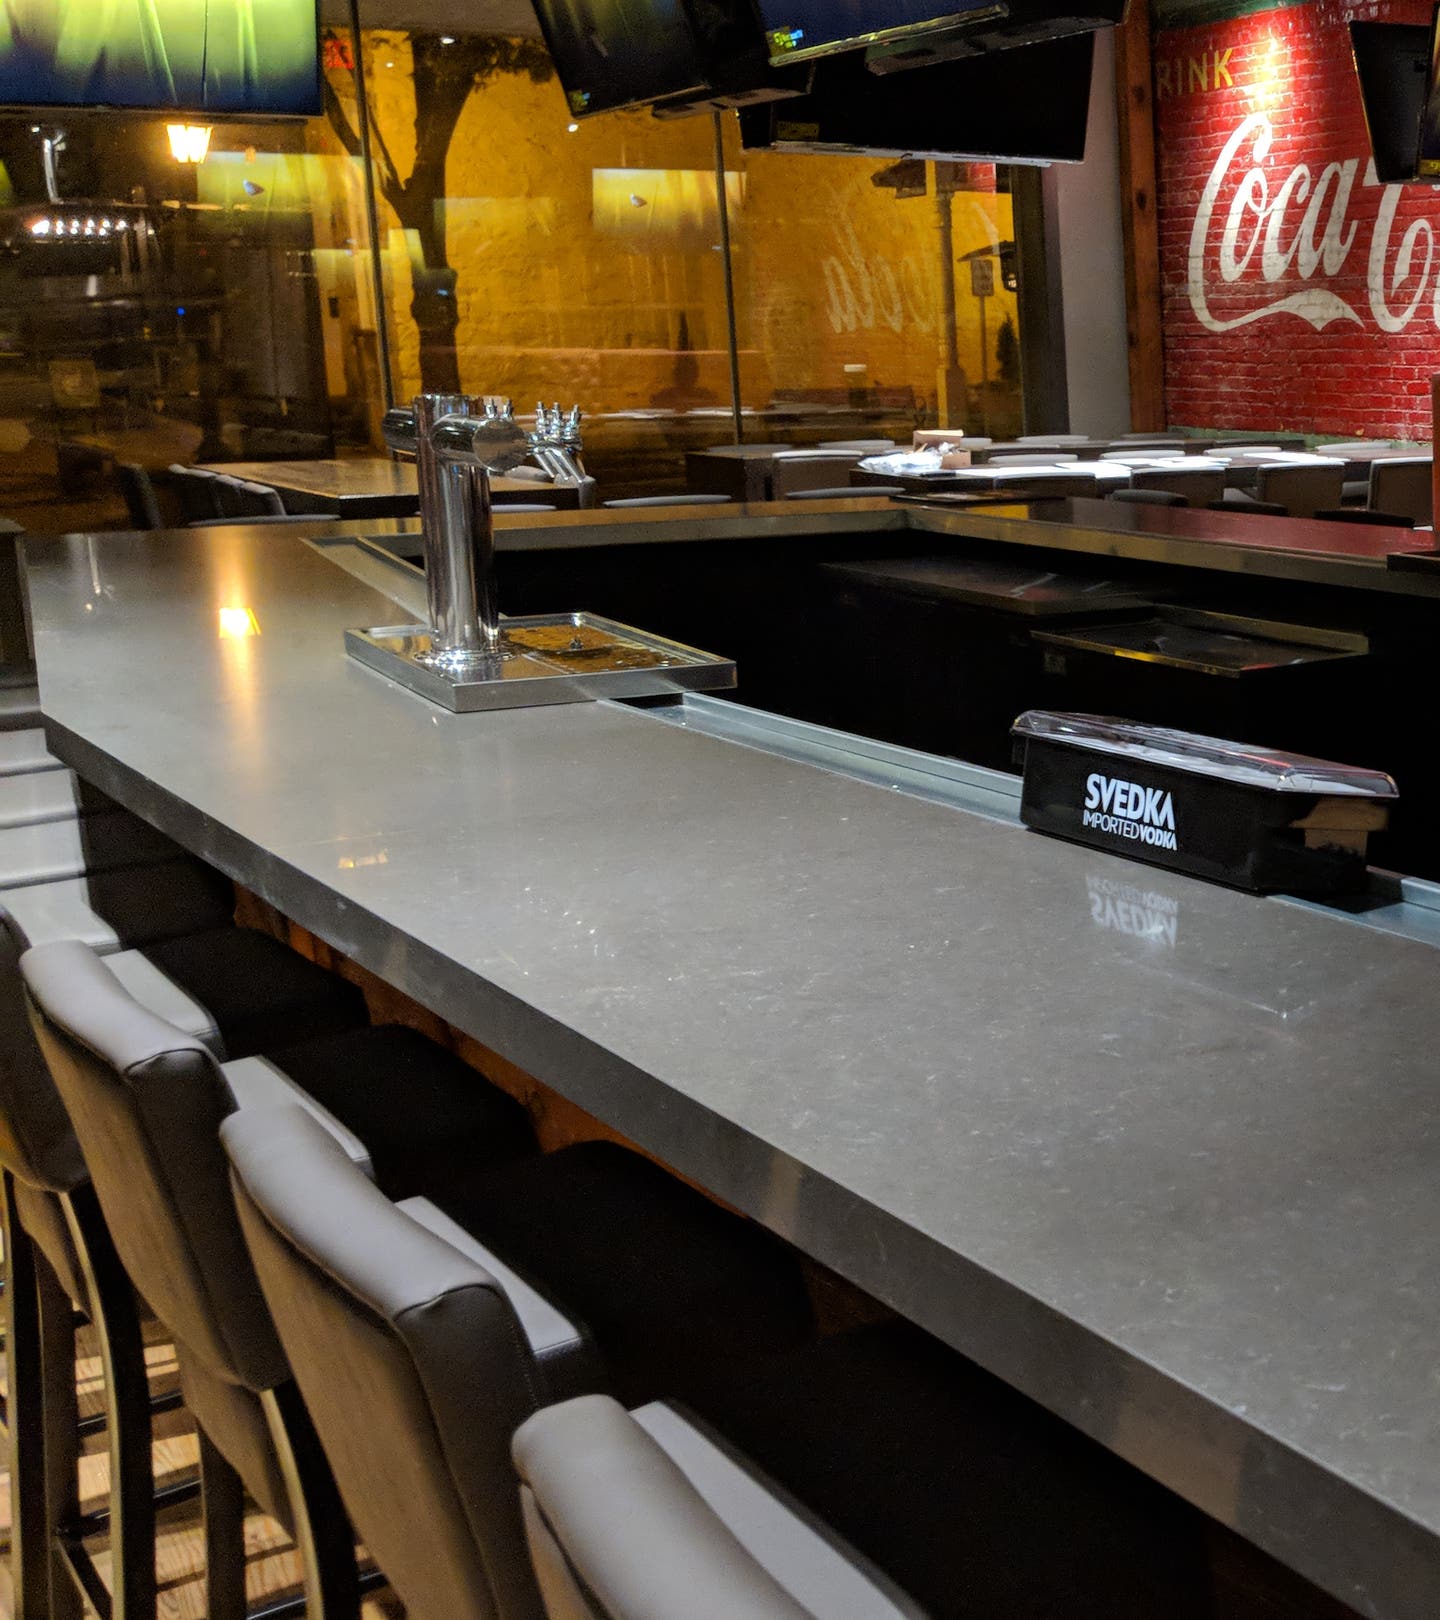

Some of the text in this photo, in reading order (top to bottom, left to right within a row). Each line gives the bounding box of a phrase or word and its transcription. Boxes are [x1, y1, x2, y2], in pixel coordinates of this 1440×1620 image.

[1155, 48, 1234, 101] RINK
[1187, 111, 1364, 332] Coca
[1084, 772, 1176, 831] SVEDKA
